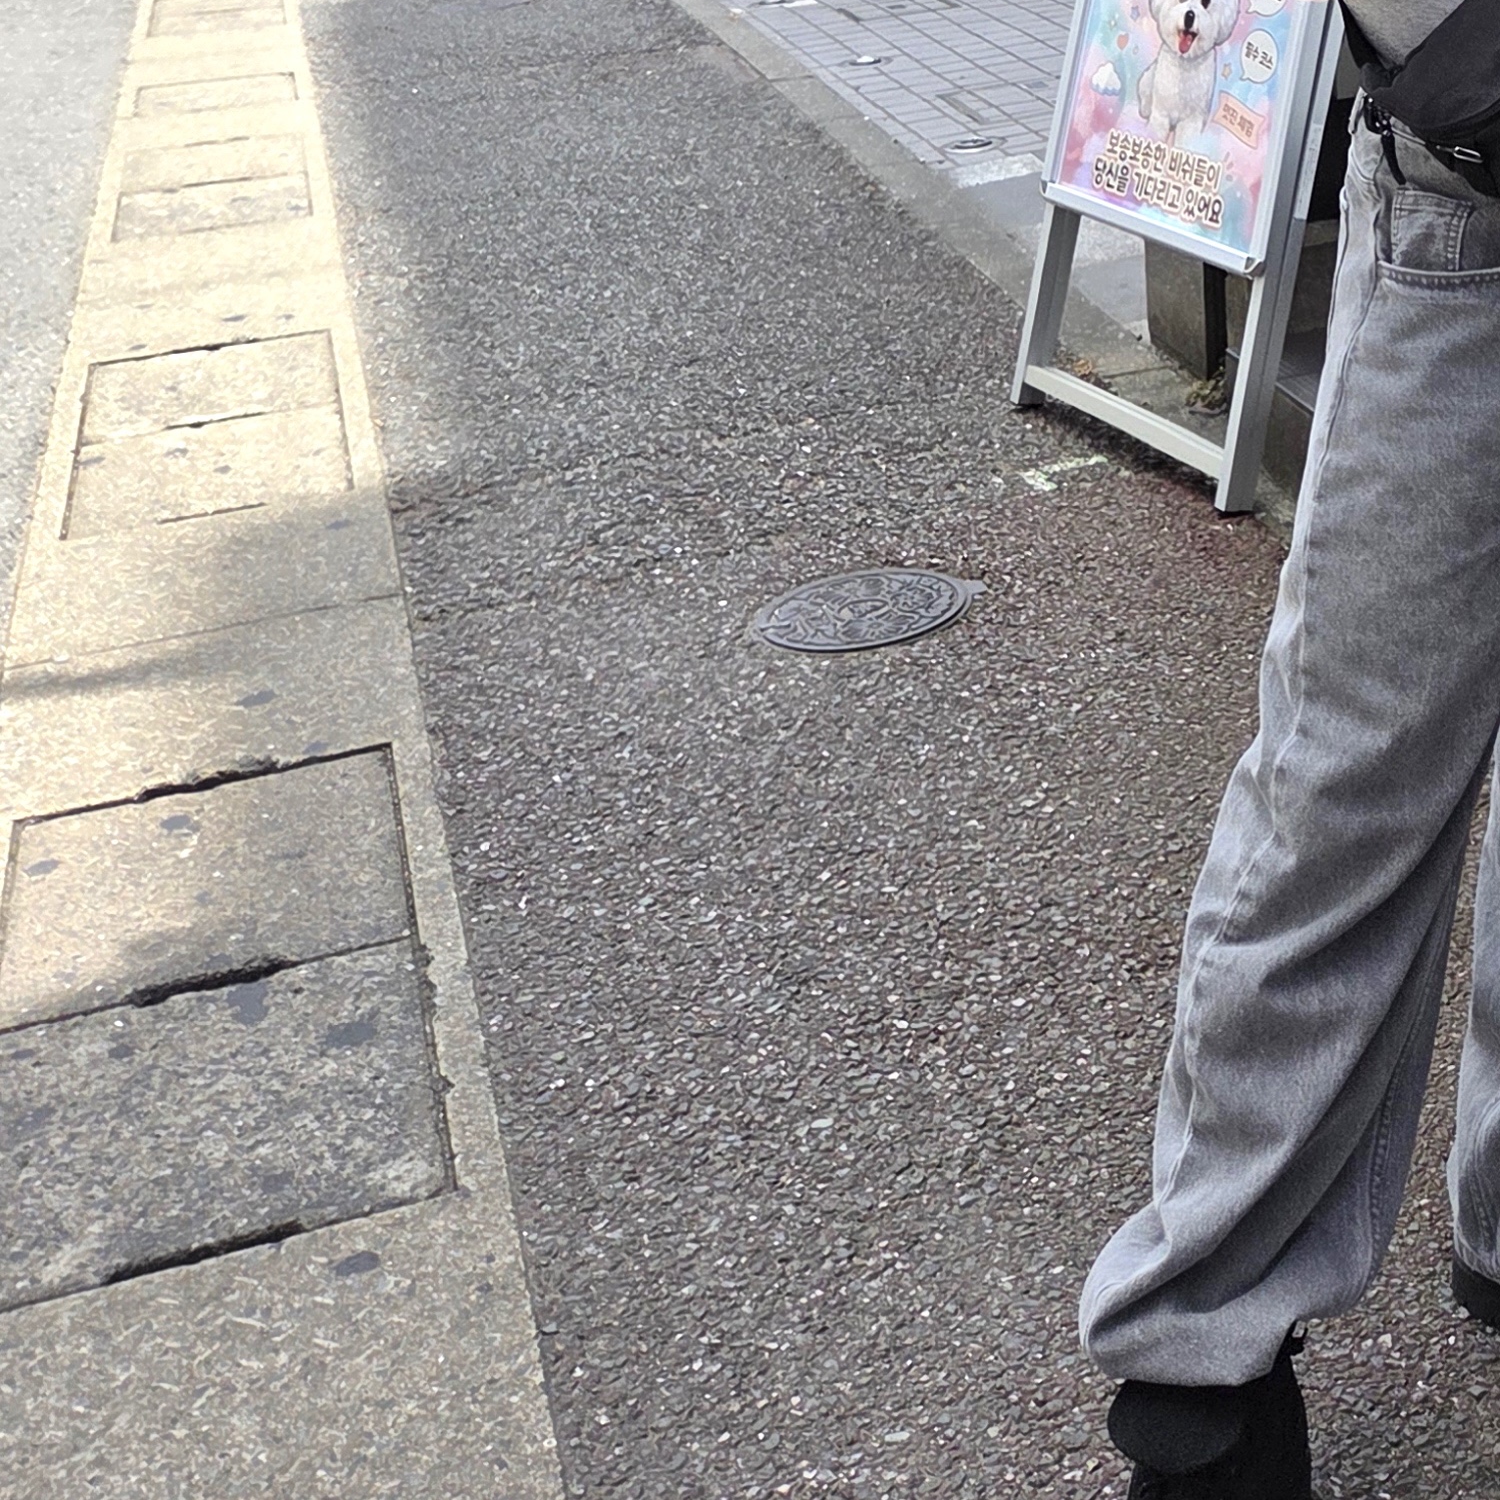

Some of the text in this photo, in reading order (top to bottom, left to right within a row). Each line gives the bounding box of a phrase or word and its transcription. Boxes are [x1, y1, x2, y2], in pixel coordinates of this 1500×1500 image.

[1106, 130, 1167, 173] 보송보송한
[1094, 157, 1223, 225] 당신을 기다리고 있어요
